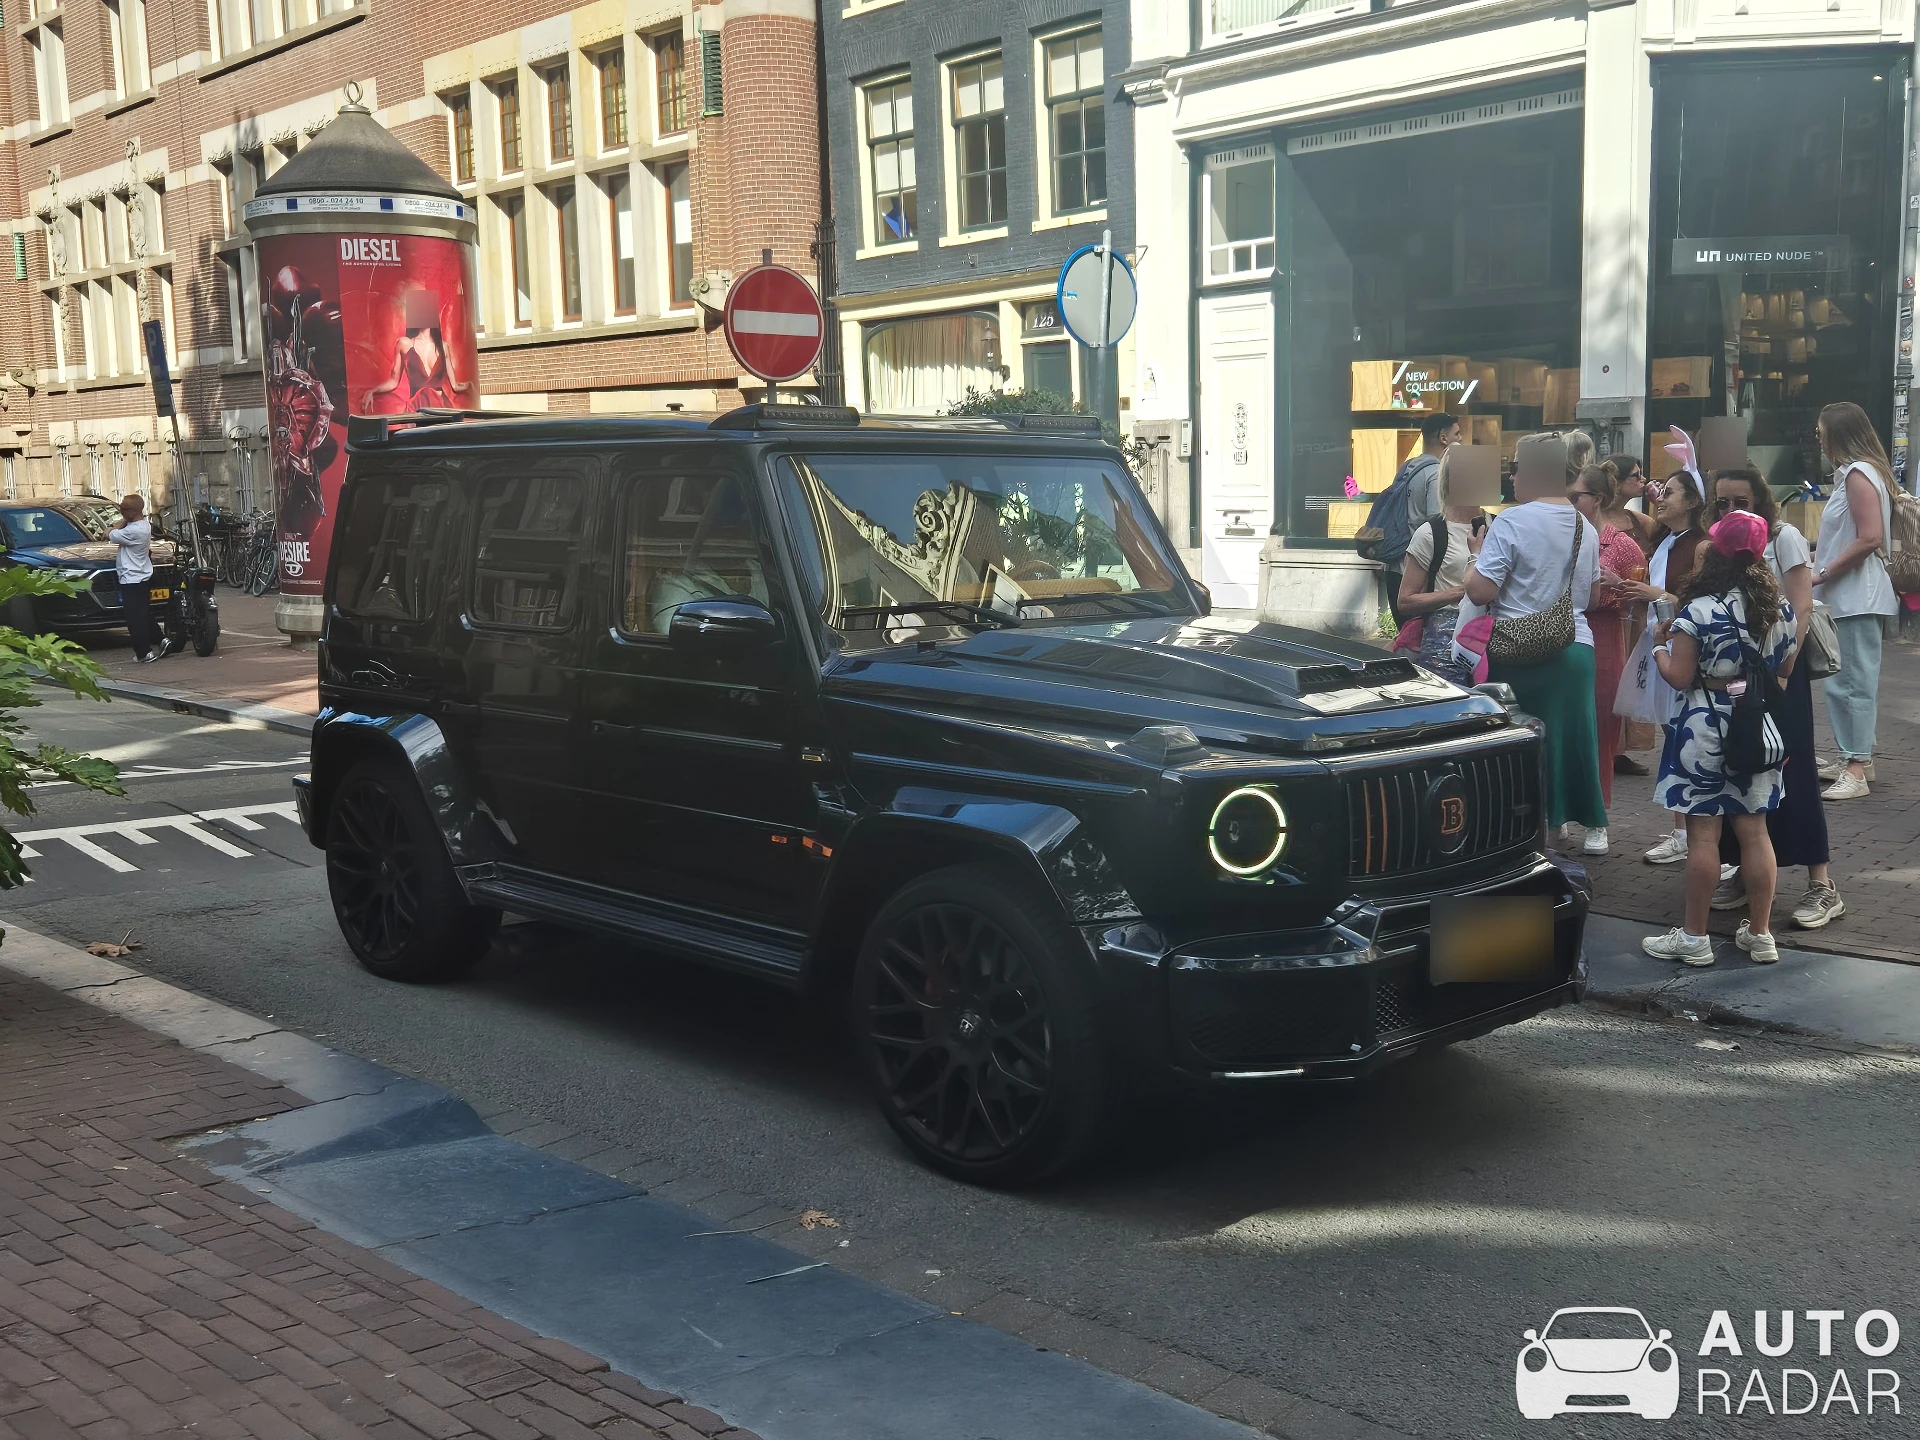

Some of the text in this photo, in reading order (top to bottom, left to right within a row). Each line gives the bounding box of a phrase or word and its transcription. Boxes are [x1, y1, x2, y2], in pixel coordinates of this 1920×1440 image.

[340, 238, 401, 261] DIESEL
[1726, 252, 1772, 262] UNITED
[1776, 251, 1811, 261] NUDE
[1405, 371, 1429, 382] NEW
[1405, 380, 1465, 392] COLLECTION
[279, 541, 311, 562] DESIRE
[1441, 797, 1465, 834] B
